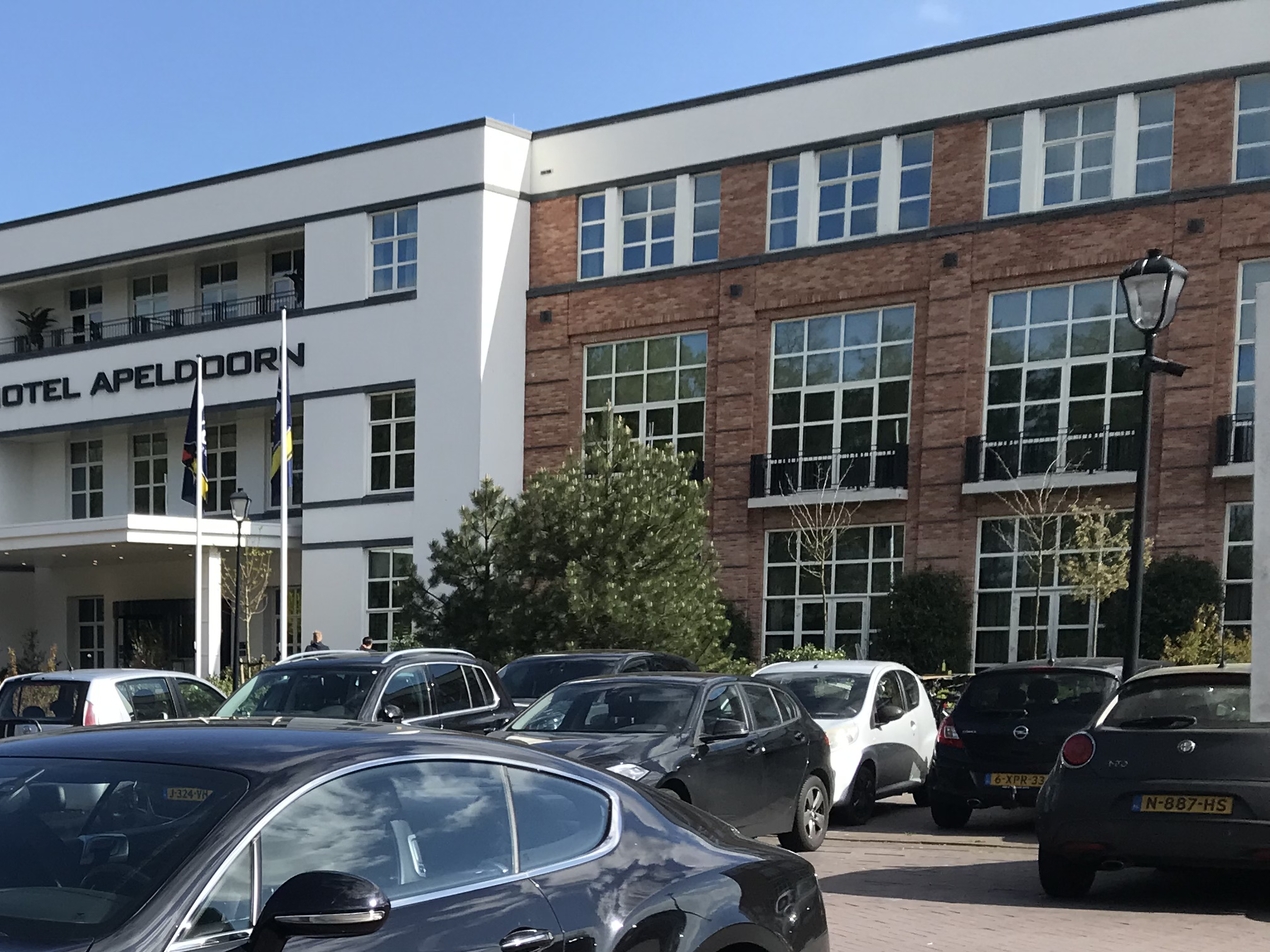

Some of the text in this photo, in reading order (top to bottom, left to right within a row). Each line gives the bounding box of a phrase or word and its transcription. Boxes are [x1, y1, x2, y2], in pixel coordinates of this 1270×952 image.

[90, 342, 305, 395] APELDOORN
[994, 774, 1045, 786] 6-XPR-33
[1145, 796, 1228, 812] N-887-HS
